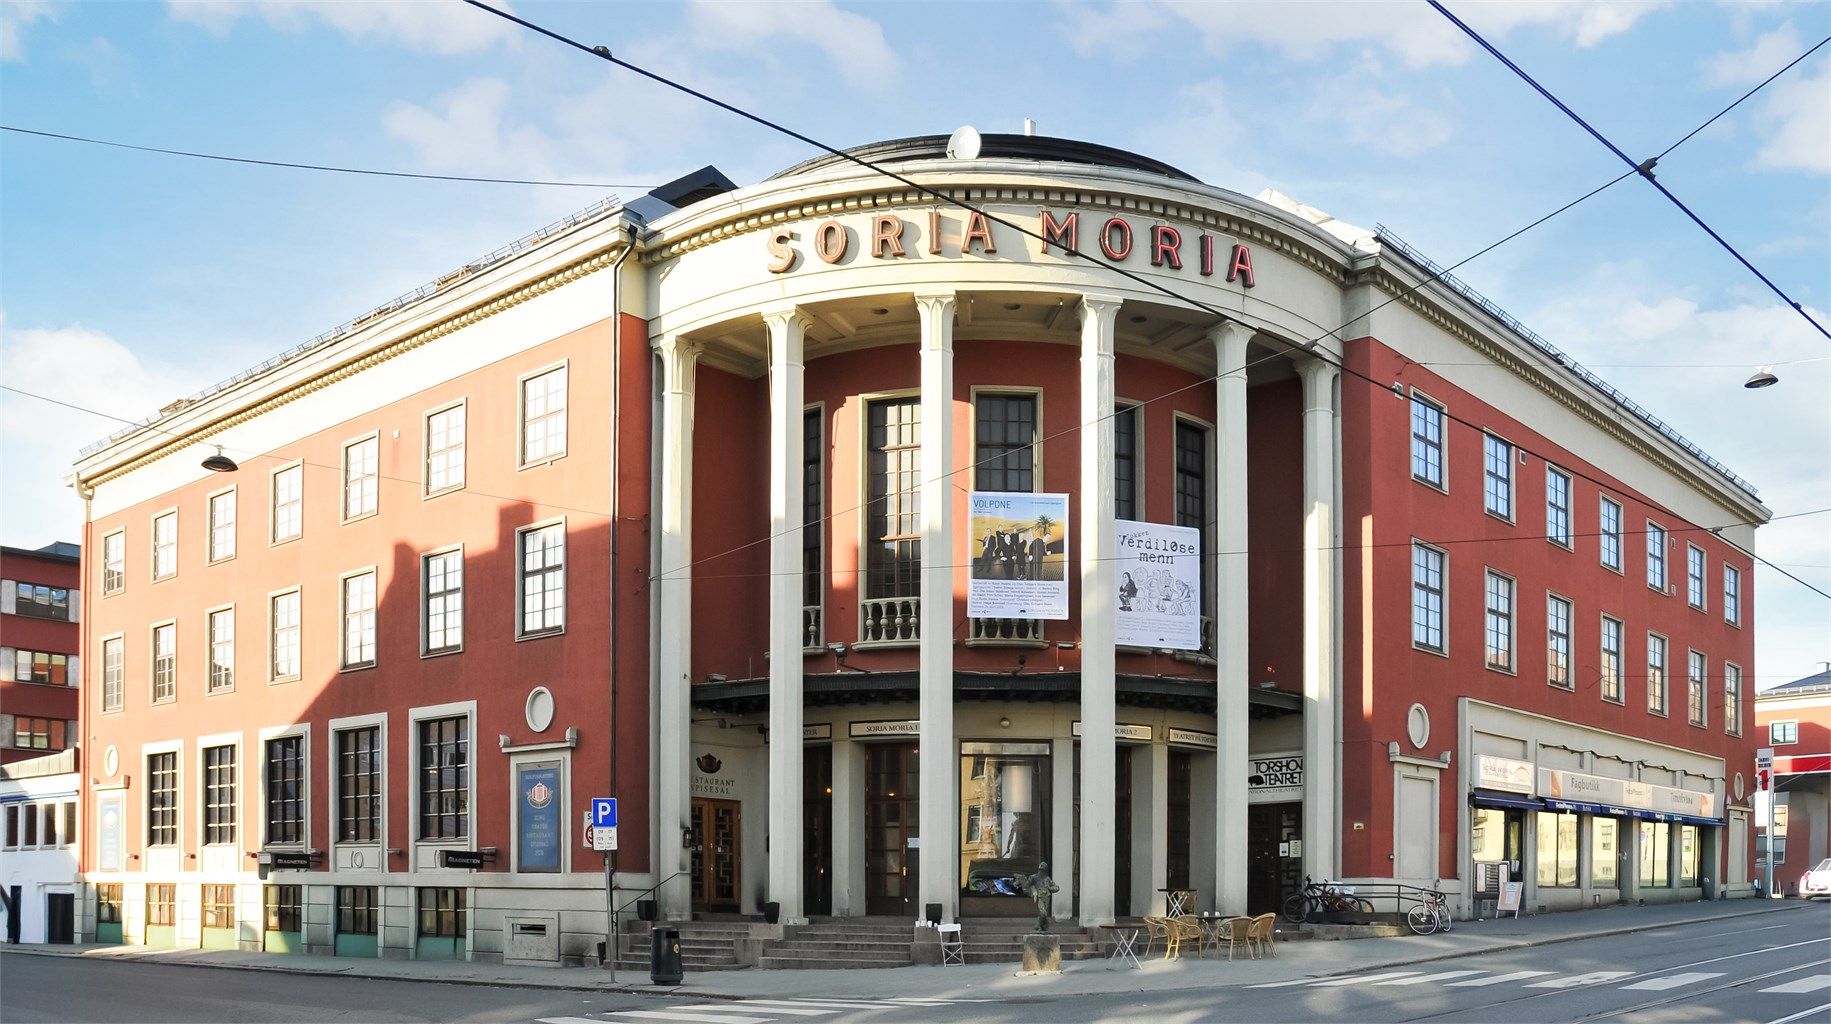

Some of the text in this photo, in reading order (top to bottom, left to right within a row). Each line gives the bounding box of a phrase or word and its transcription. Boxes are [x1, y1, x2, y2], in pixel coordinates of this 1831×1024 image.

[767, 210, 1256, 288] SORIA MORIA
[973, 499, 1011, 509] VOLPONE
[1139, 552, 1174, 565] menn
[866, 725, 888, 733] SORIA
[889, 724, 915, 732] MORIA
[1254, 759, 1303, 773] TORSHOV
[1264, 771, 1303, 785] TEATRET
[1571, 777, 1600, 792] Fagbutikk
[598, 802, 611, 824] P
